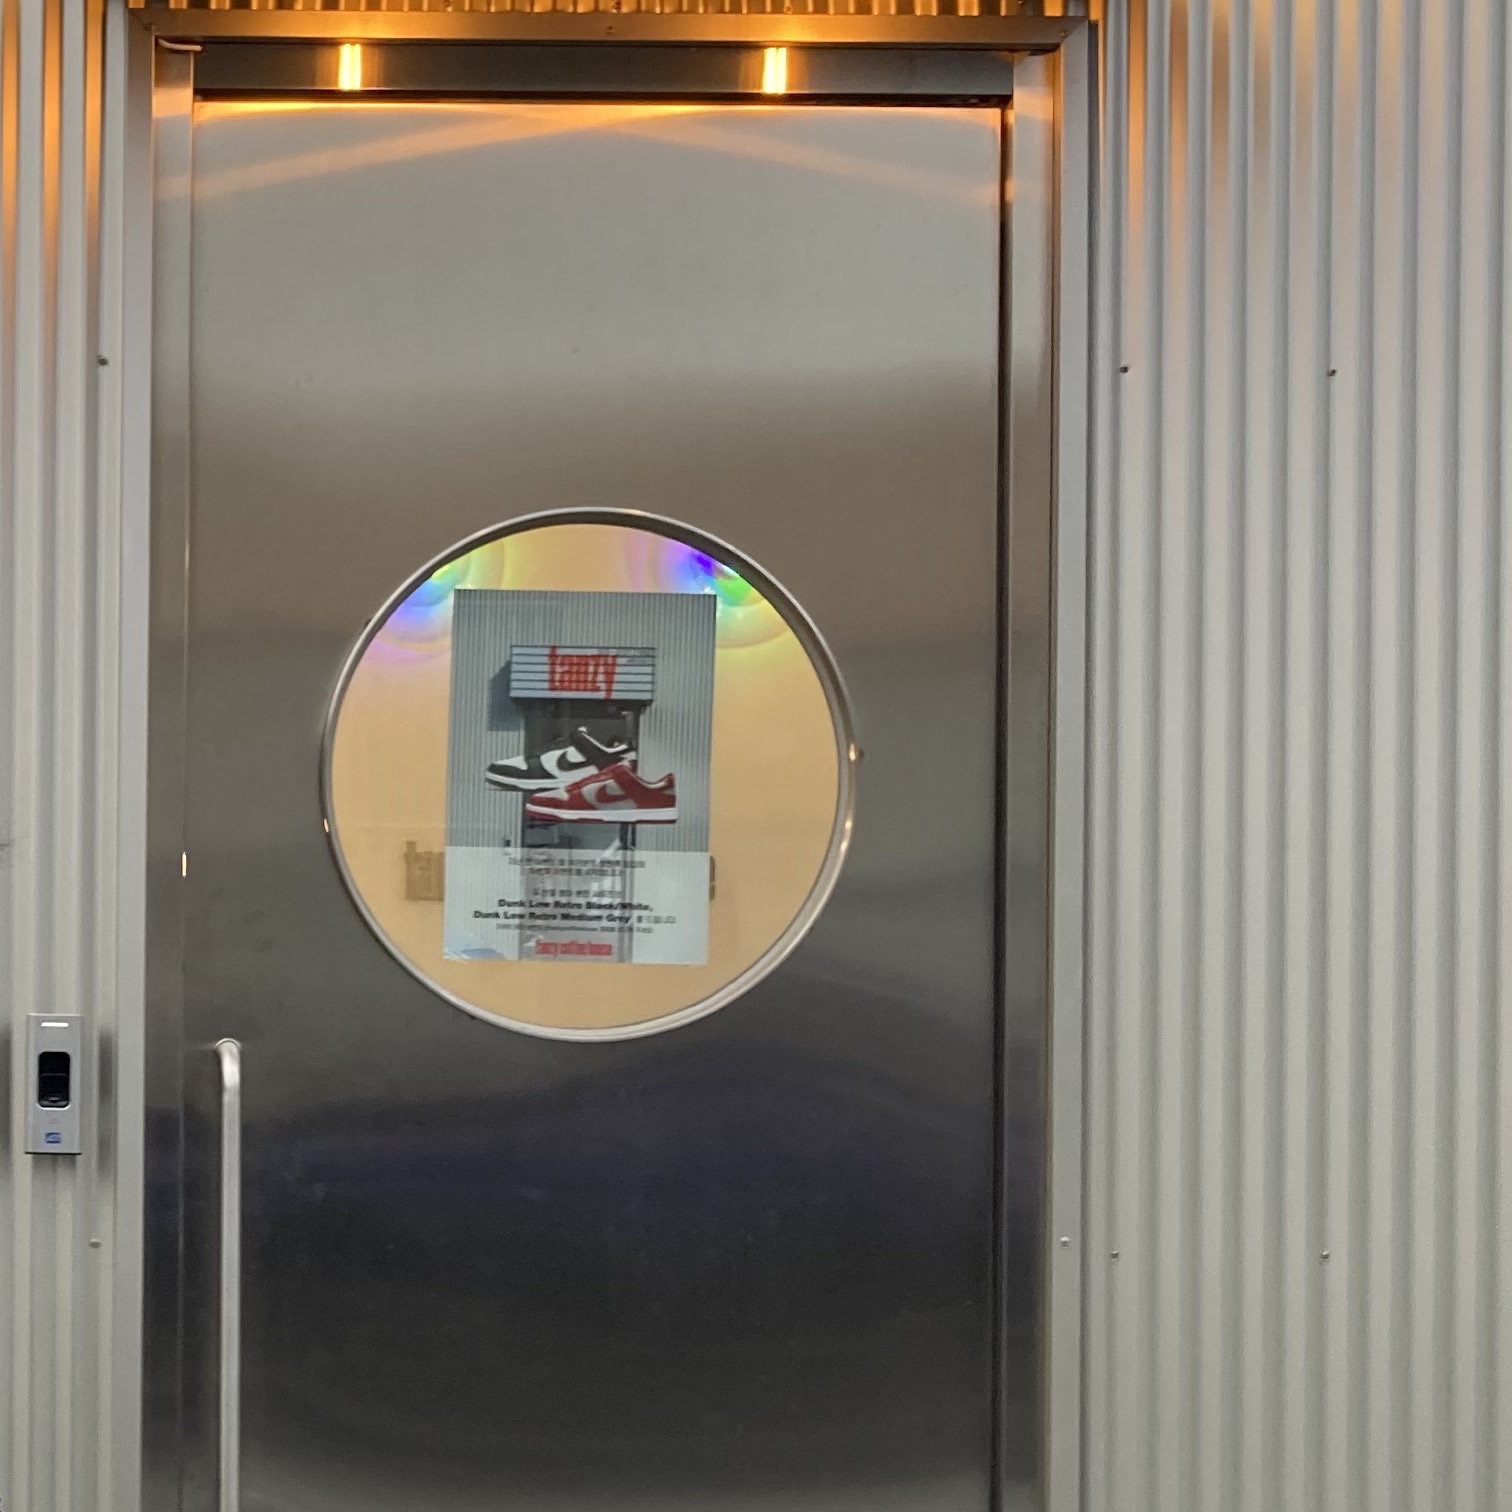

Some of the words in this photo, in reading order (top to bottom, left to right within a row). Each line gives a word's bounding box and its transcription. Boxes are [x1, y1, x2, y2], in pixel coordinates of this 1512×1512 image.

[498, 899, 526, 908] Dunk
[529, 900, 550, 909] Low
[554, 900, 582, 910] Retro
[473, 910, 500, 919] Dunk
[503, 911, 526, 920] Low
[529, 912, 557, 921] Retro
[560, 912, 603, 922] Medium
